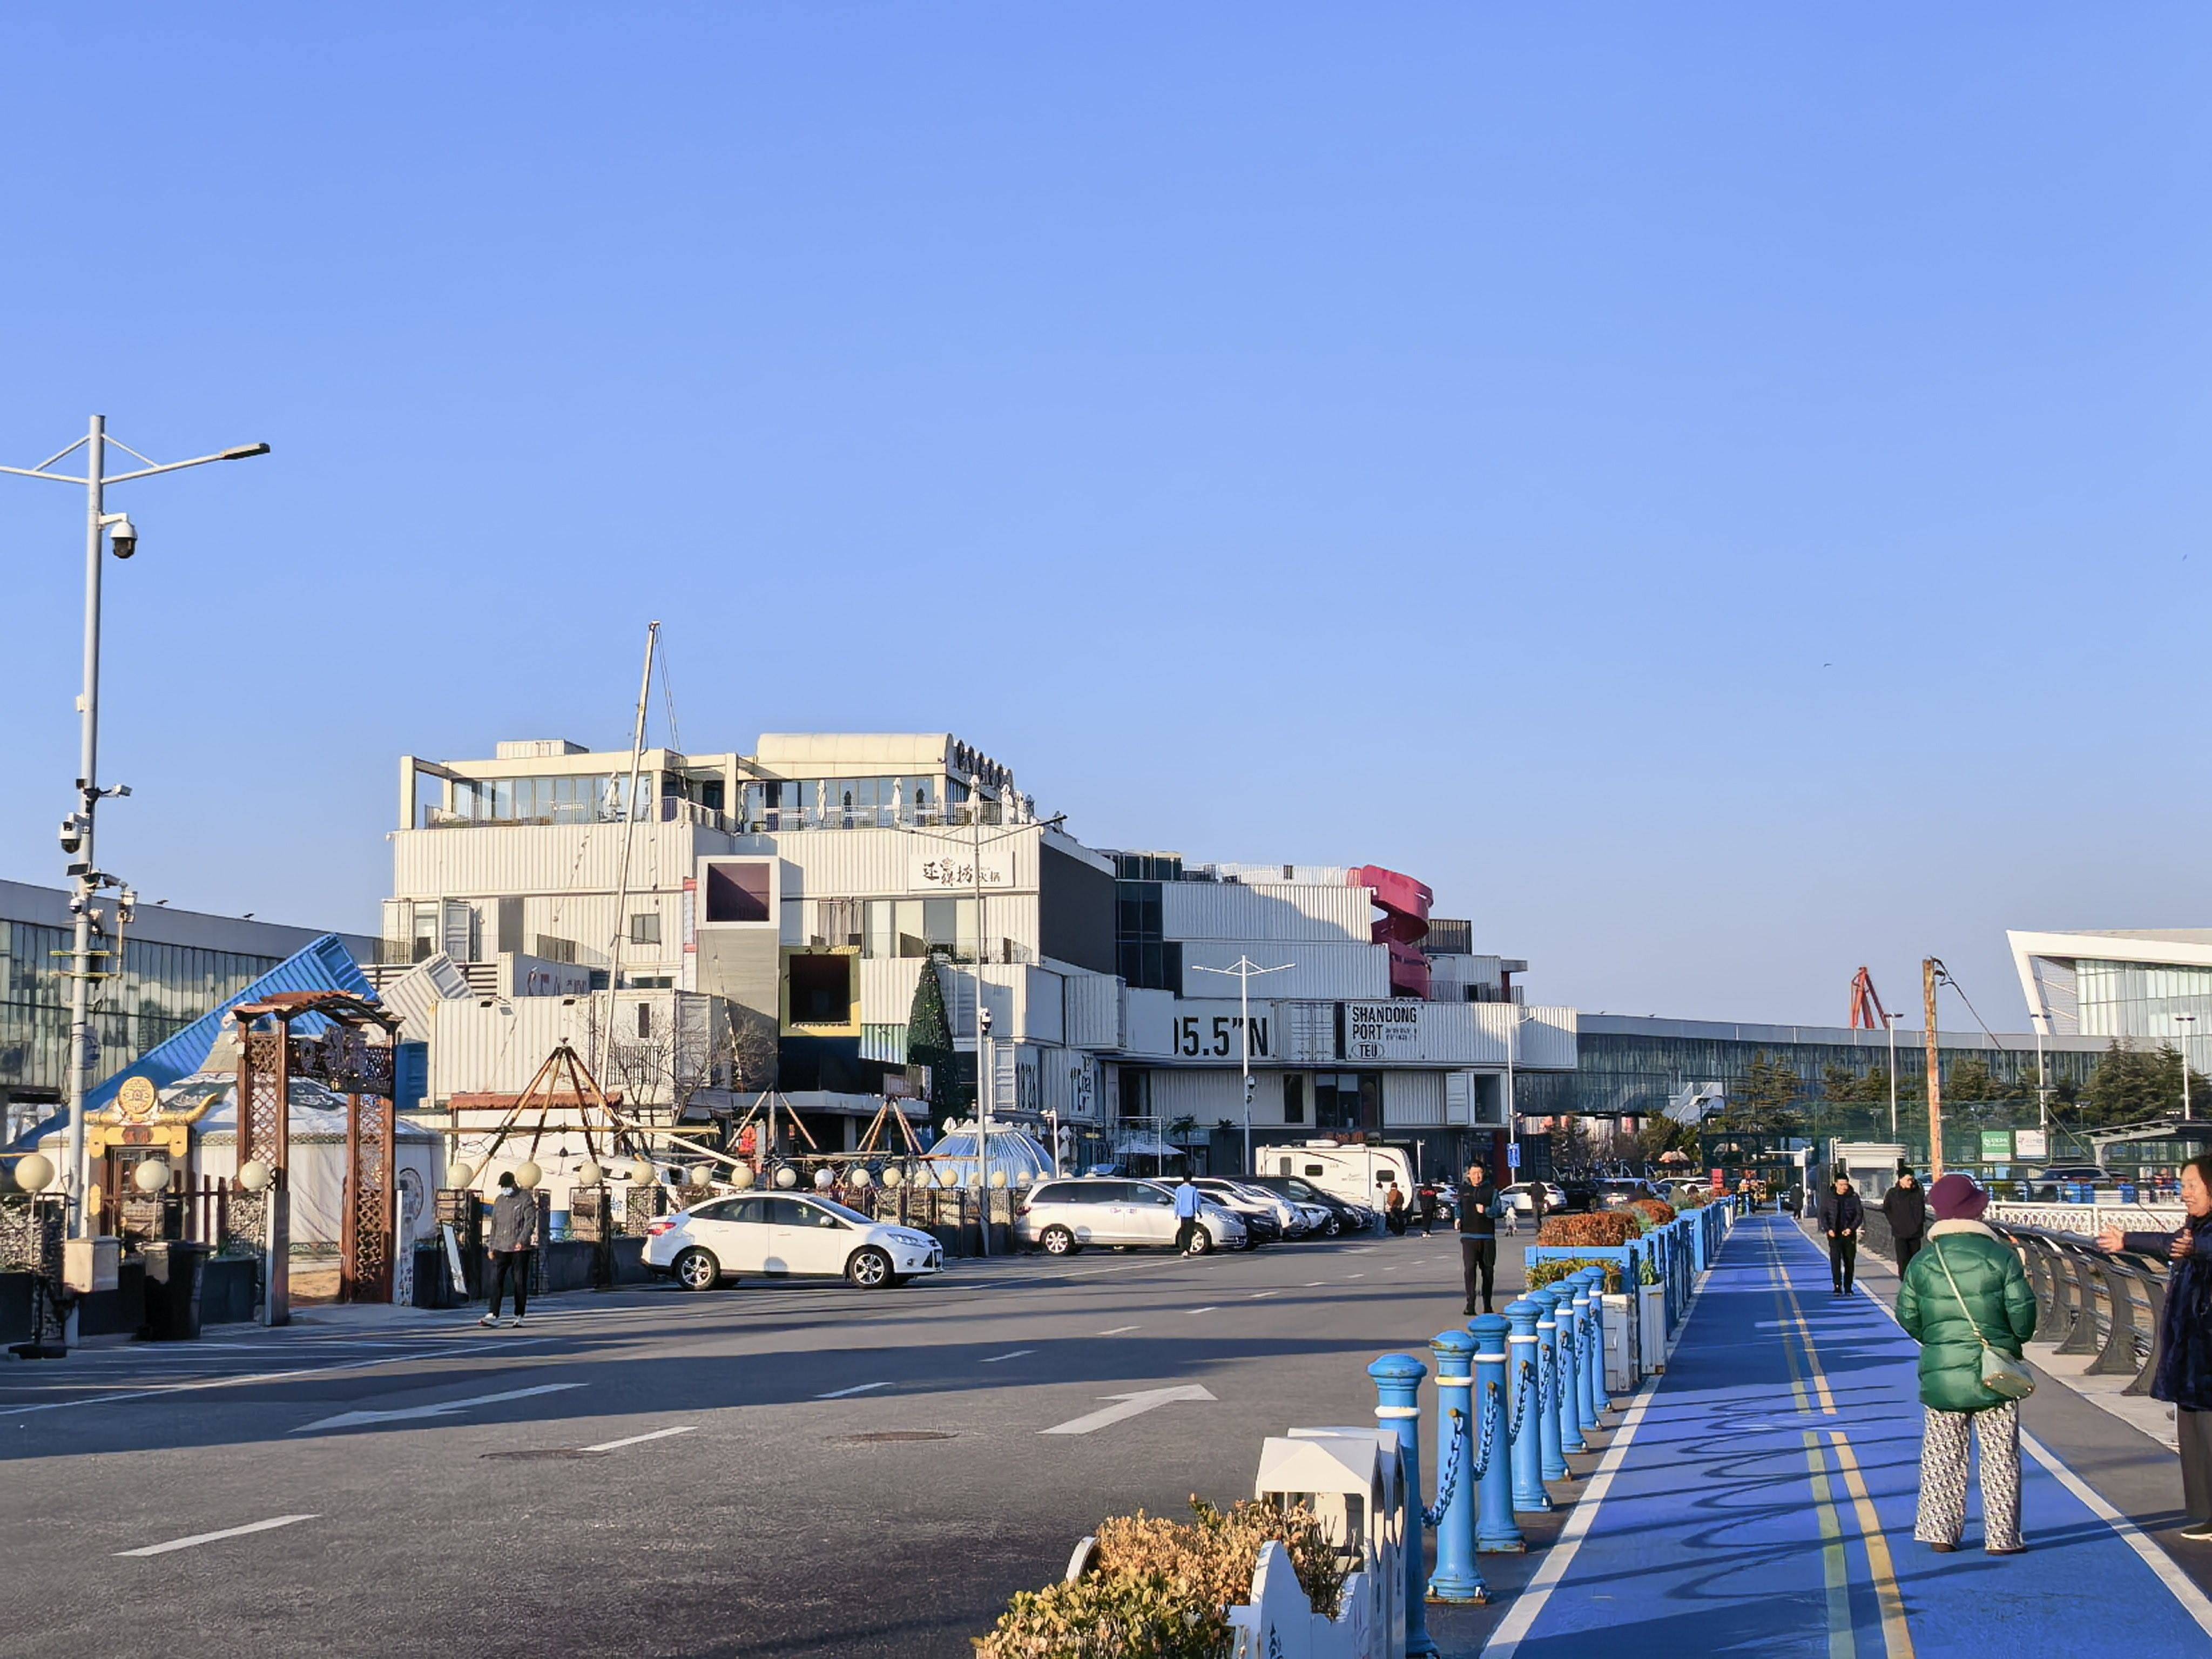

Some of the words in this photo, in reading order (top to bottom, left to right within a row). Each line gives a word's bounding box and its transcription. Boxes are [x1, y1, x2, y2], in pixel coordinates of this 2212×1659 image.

[1352, 1007, 1417, 1022] SHANDONG
[1352, 1024, 1383, 1040] PORT
[1359, 1044, 1378, 1057] TEU
